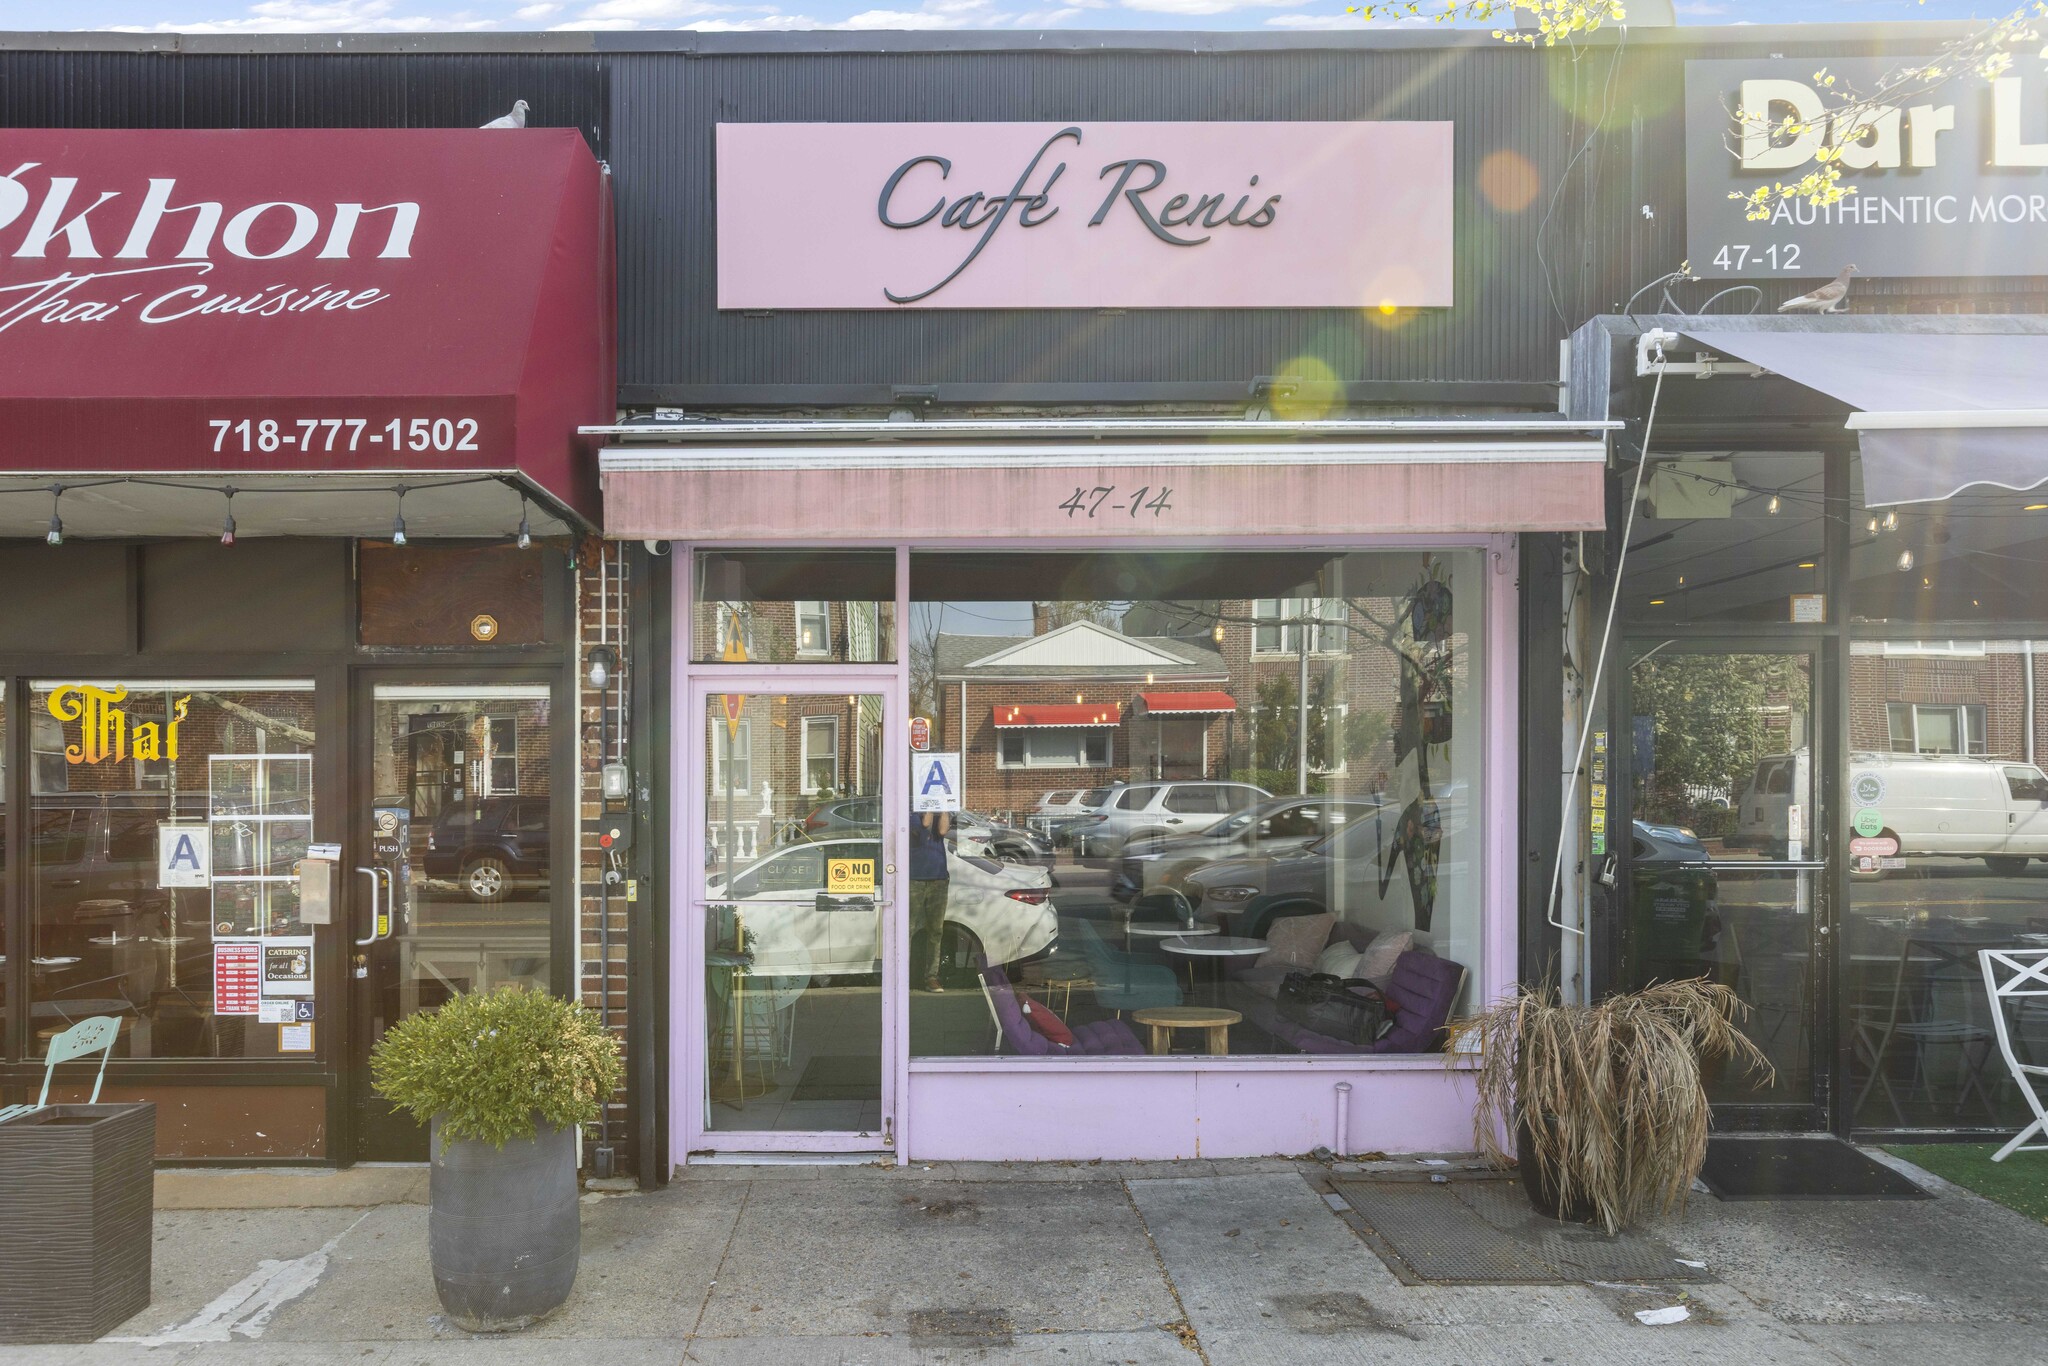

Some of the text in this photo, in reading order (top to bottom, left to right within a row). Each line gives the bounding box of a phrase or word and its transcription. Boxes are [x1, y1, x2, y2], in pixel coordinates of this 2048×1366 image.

[1741, 79, 1955, 170] Dar
[0, 163, 420, 260] khon
[878, 126, 1282, 304] Café Renis
[1771, 194, 2048, 225] AUTHENTIC MOR
[1713, 243, 1801, 271] 47-12
[140, 283, 390, 323] Cuisine
[209, 418, 479, 452] 718-777-1502
[1059, 485, 1173, 519] 47-14
[47, 683, 192, 765] Thai
[921, 760, 952, 795] A
[1860, 815, 1877, 823] Uber
[168, 834, 201, 869] A
[852, 863, 871, 875] NO
[269, 963, 278, 971] for
